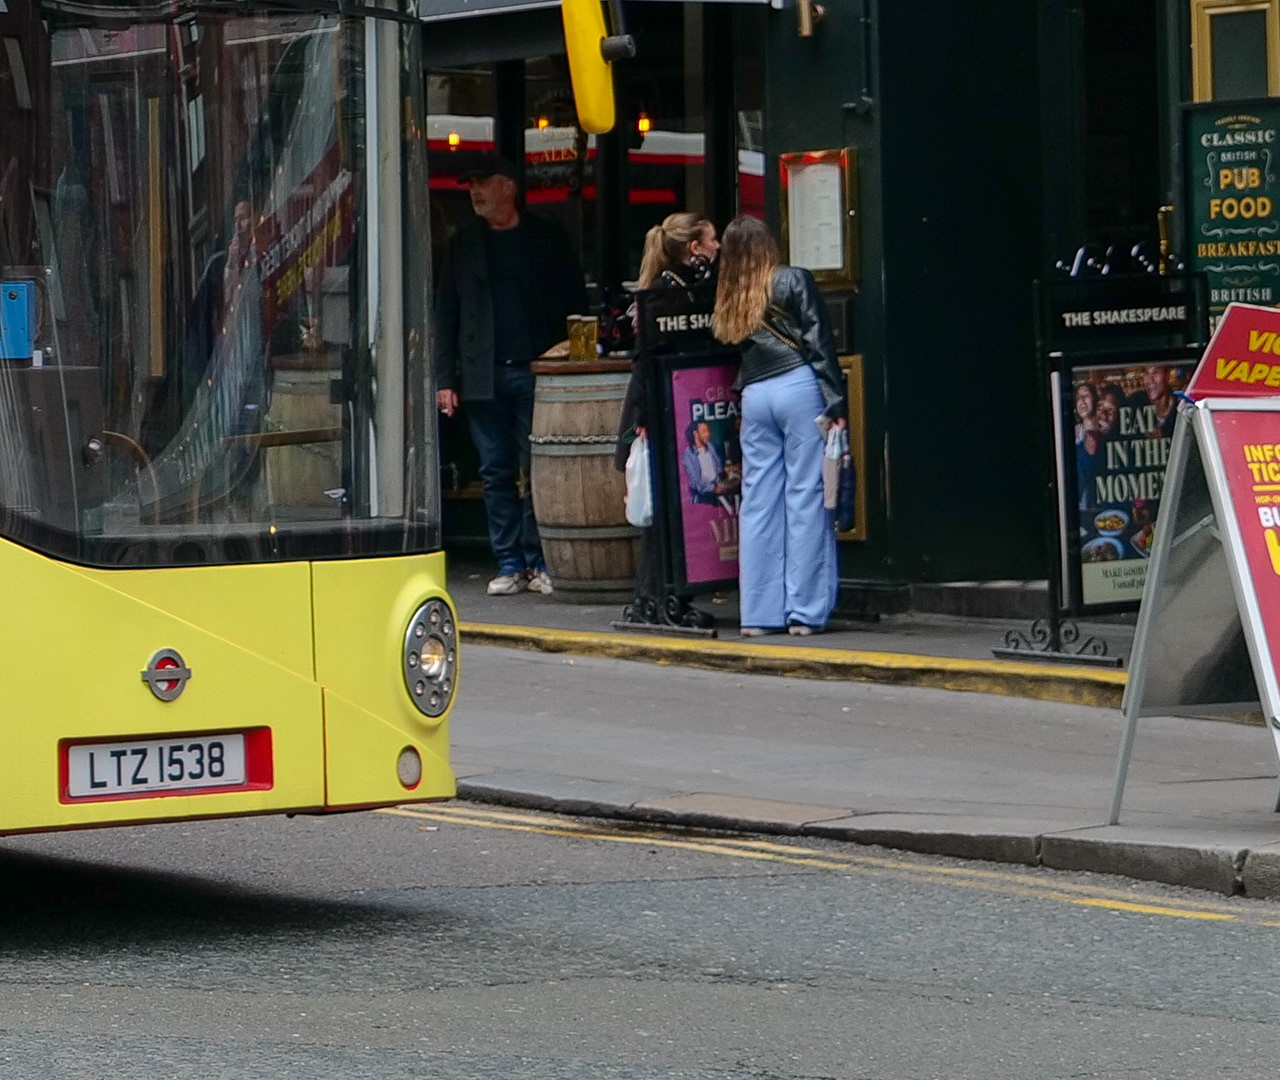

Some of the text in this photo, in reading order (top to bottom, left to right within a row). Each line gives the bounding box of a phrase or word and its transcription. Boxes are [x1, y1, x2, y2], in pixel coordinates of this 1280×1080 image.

[1201, 128, 1275, 147] CLASSIC
[1220, 150, 1257, 163] BRITISH
[1219, 167, 1262, 190] PUB
[1209, 196, 1273, 220] FOOD
[1210, 287, 1273, 303] BRITISH
[656, 315, 688, 333] THE
[1061, 305, 1186, 328] THE SHAKESPEARE
[1119, 404, 1157, 436] EAT
[1105, 437, 1171, 470] IN THE
[90, 741, 225, 789] LTZ 1538
